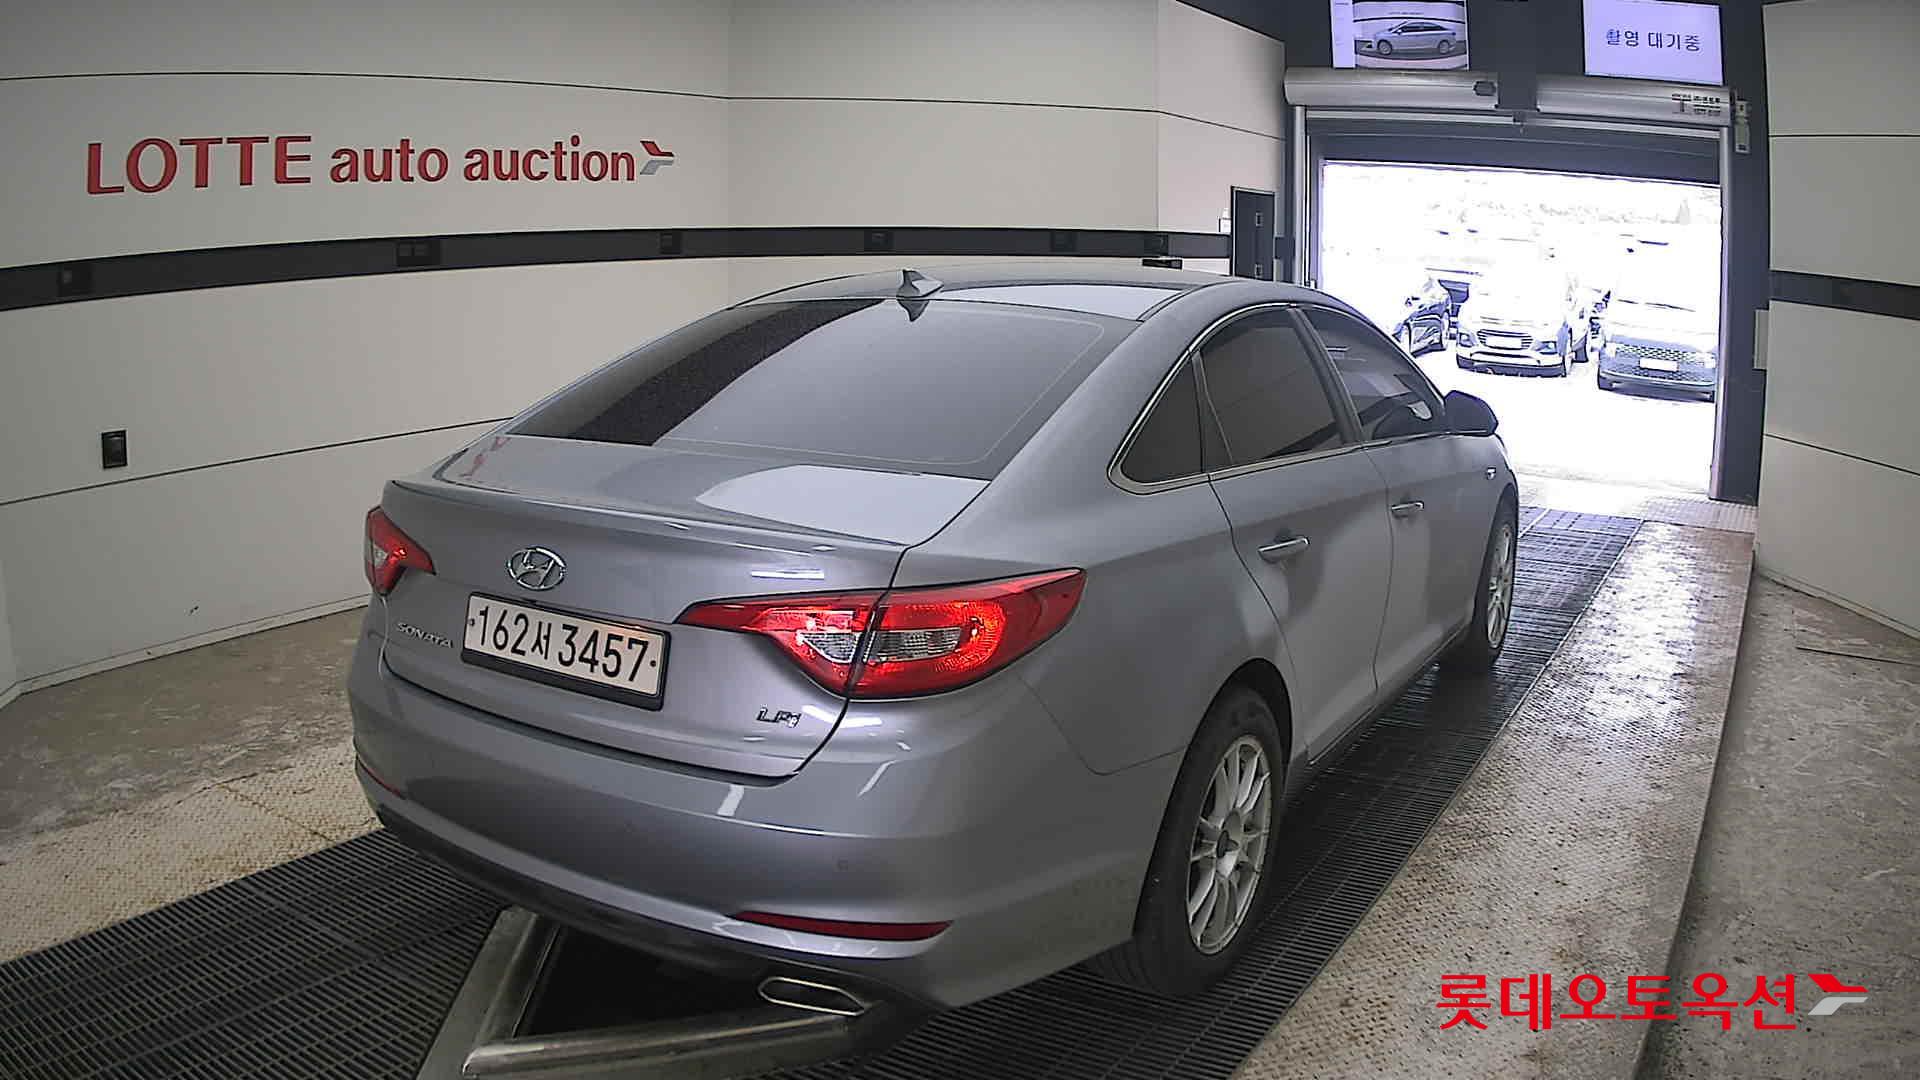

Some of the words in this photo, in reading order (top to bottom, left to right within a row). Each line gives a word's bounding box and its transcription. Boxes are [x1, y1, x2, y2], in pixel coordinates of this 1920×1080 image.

[1647, 31, 1701, 52] 대기중
[87, 136, 311, 195] LOTTE
[330, 138, 449, 183] auto
[463, 135, 635, 182] auction
[397, 622, 454, 648] SONATA
